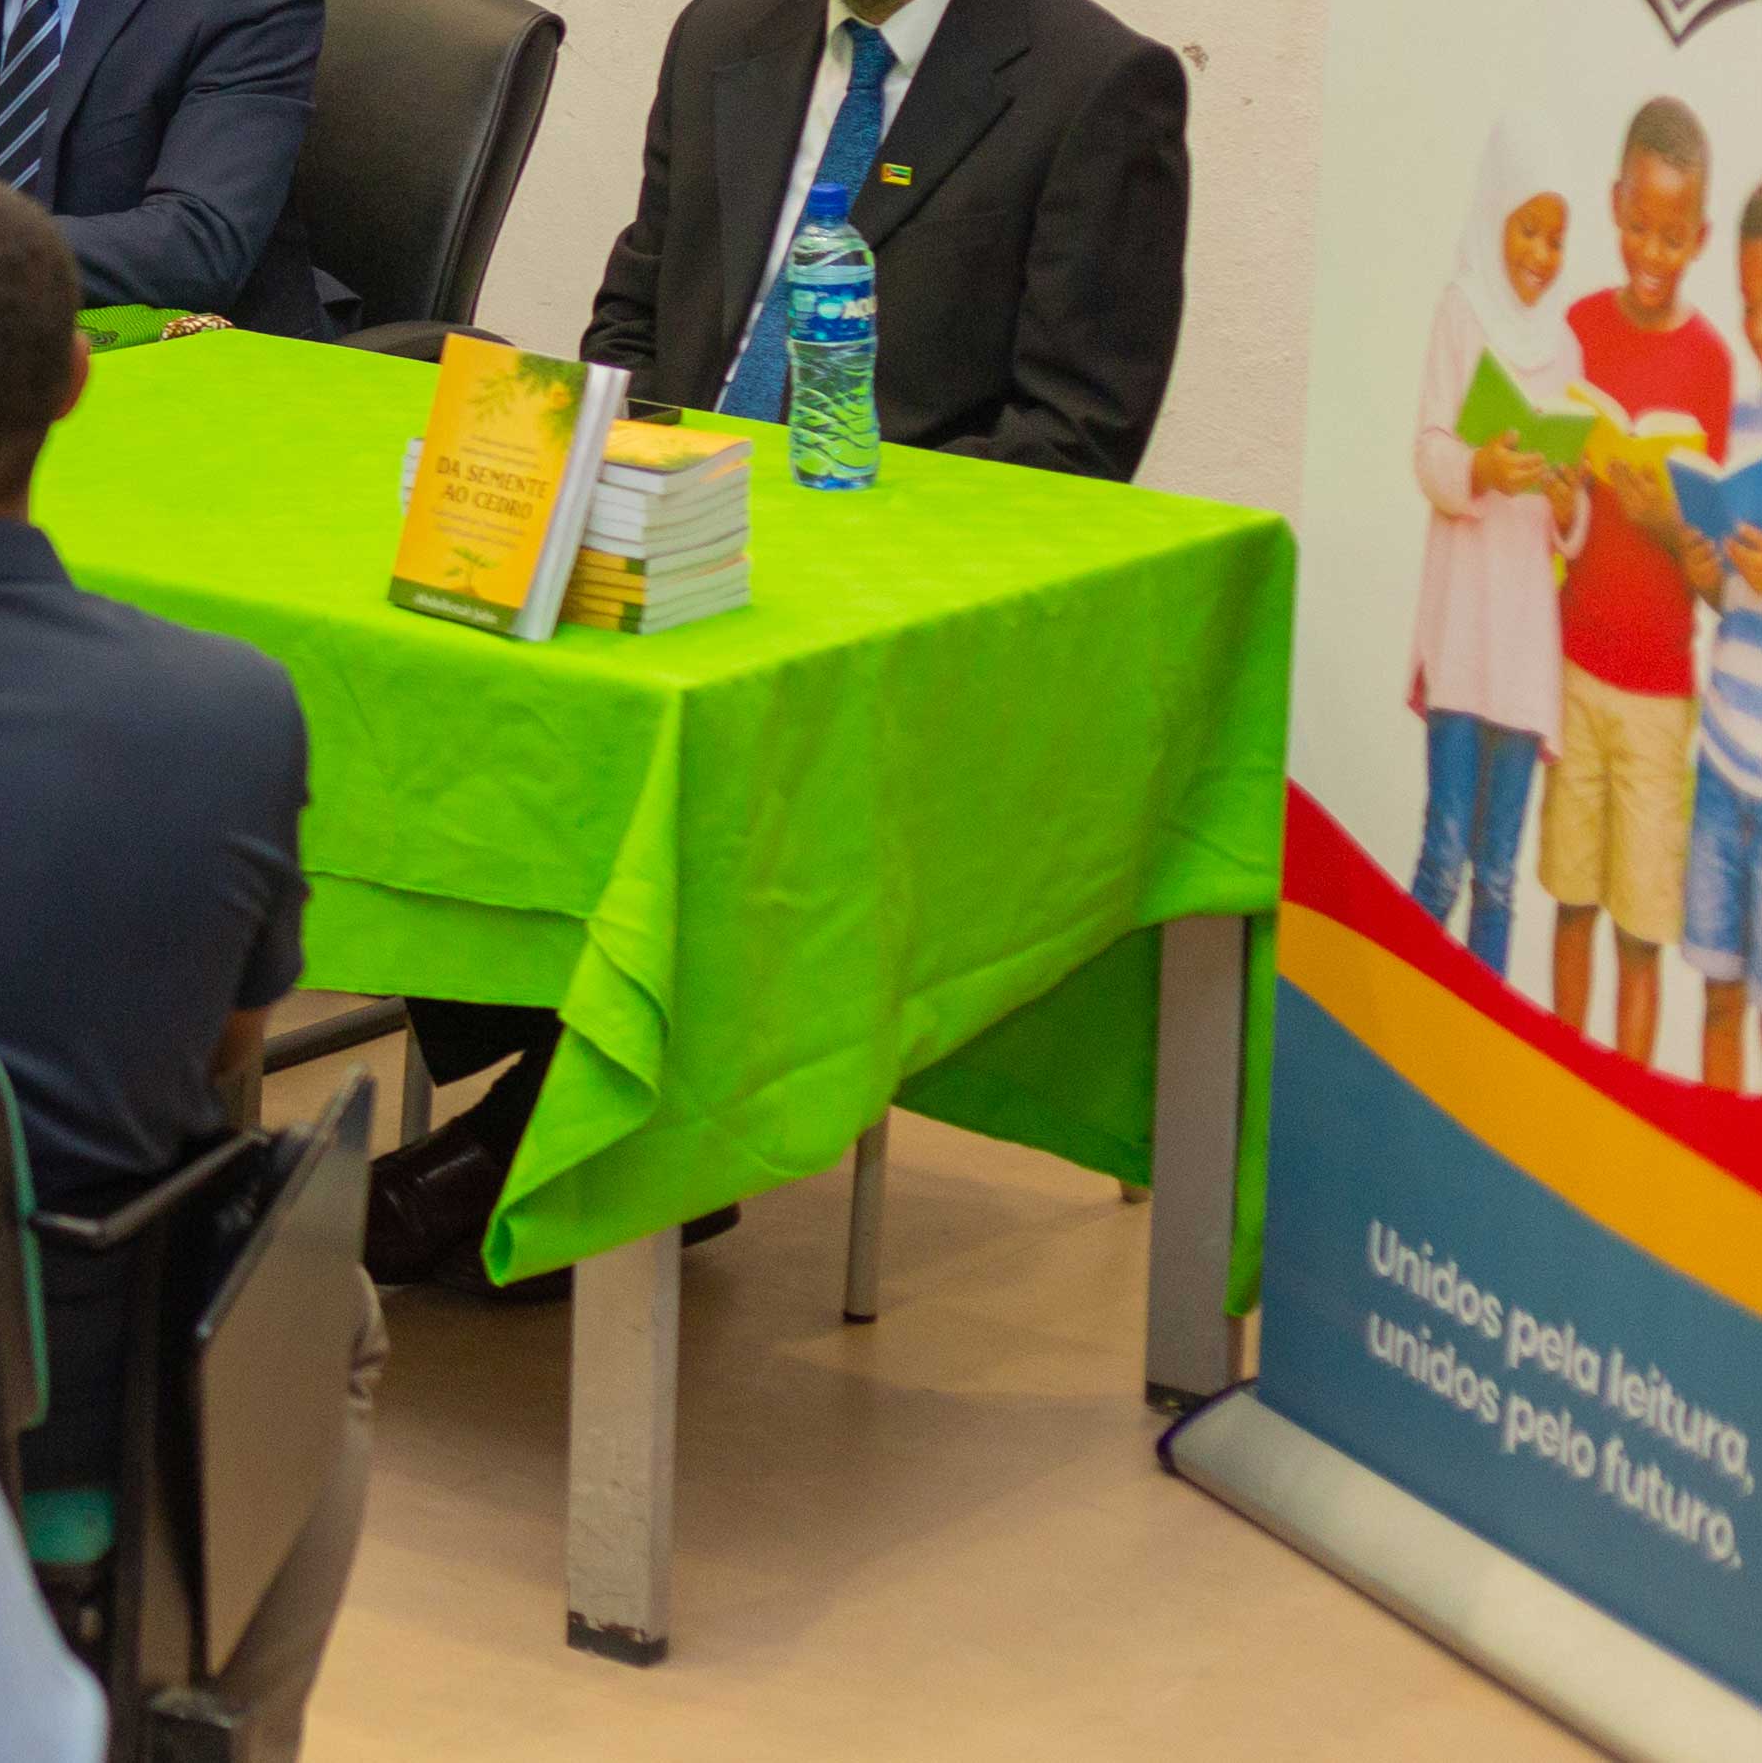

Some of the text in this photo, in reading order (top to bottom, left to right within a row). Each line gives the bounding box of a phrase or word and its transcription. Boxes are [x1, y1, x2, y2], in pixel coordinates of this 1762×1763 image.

[436, 455, 461, 479] DA
[467, 464, 552, 500] SEMENTE
[443, 482, 533, 521] AO CEDRO
[1368, 1312, 1502, 1425] unidos
[1503, 1394, 1597, 1480] pelo
[1369, 1218, 1756, 1496] Unidos pela leitura,
